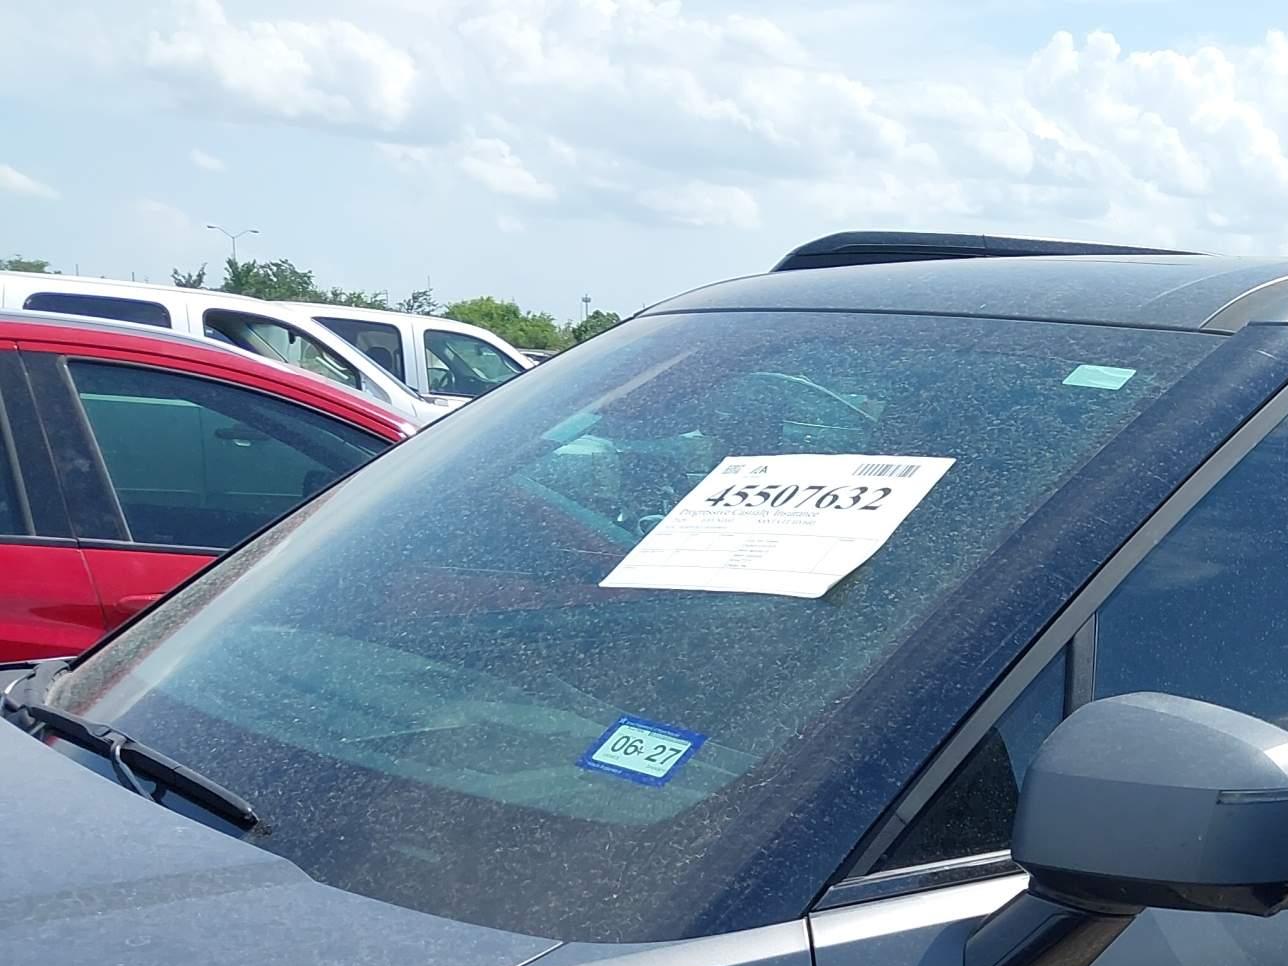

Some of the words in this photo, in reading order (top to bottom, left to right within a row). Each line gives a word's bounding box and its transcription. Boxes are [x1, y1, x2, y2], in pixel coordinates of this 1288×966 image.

[705, 484, 893, 510] 45507632
[610, 735, 644, 756] 06
[644, 744, 683, 765] 27
